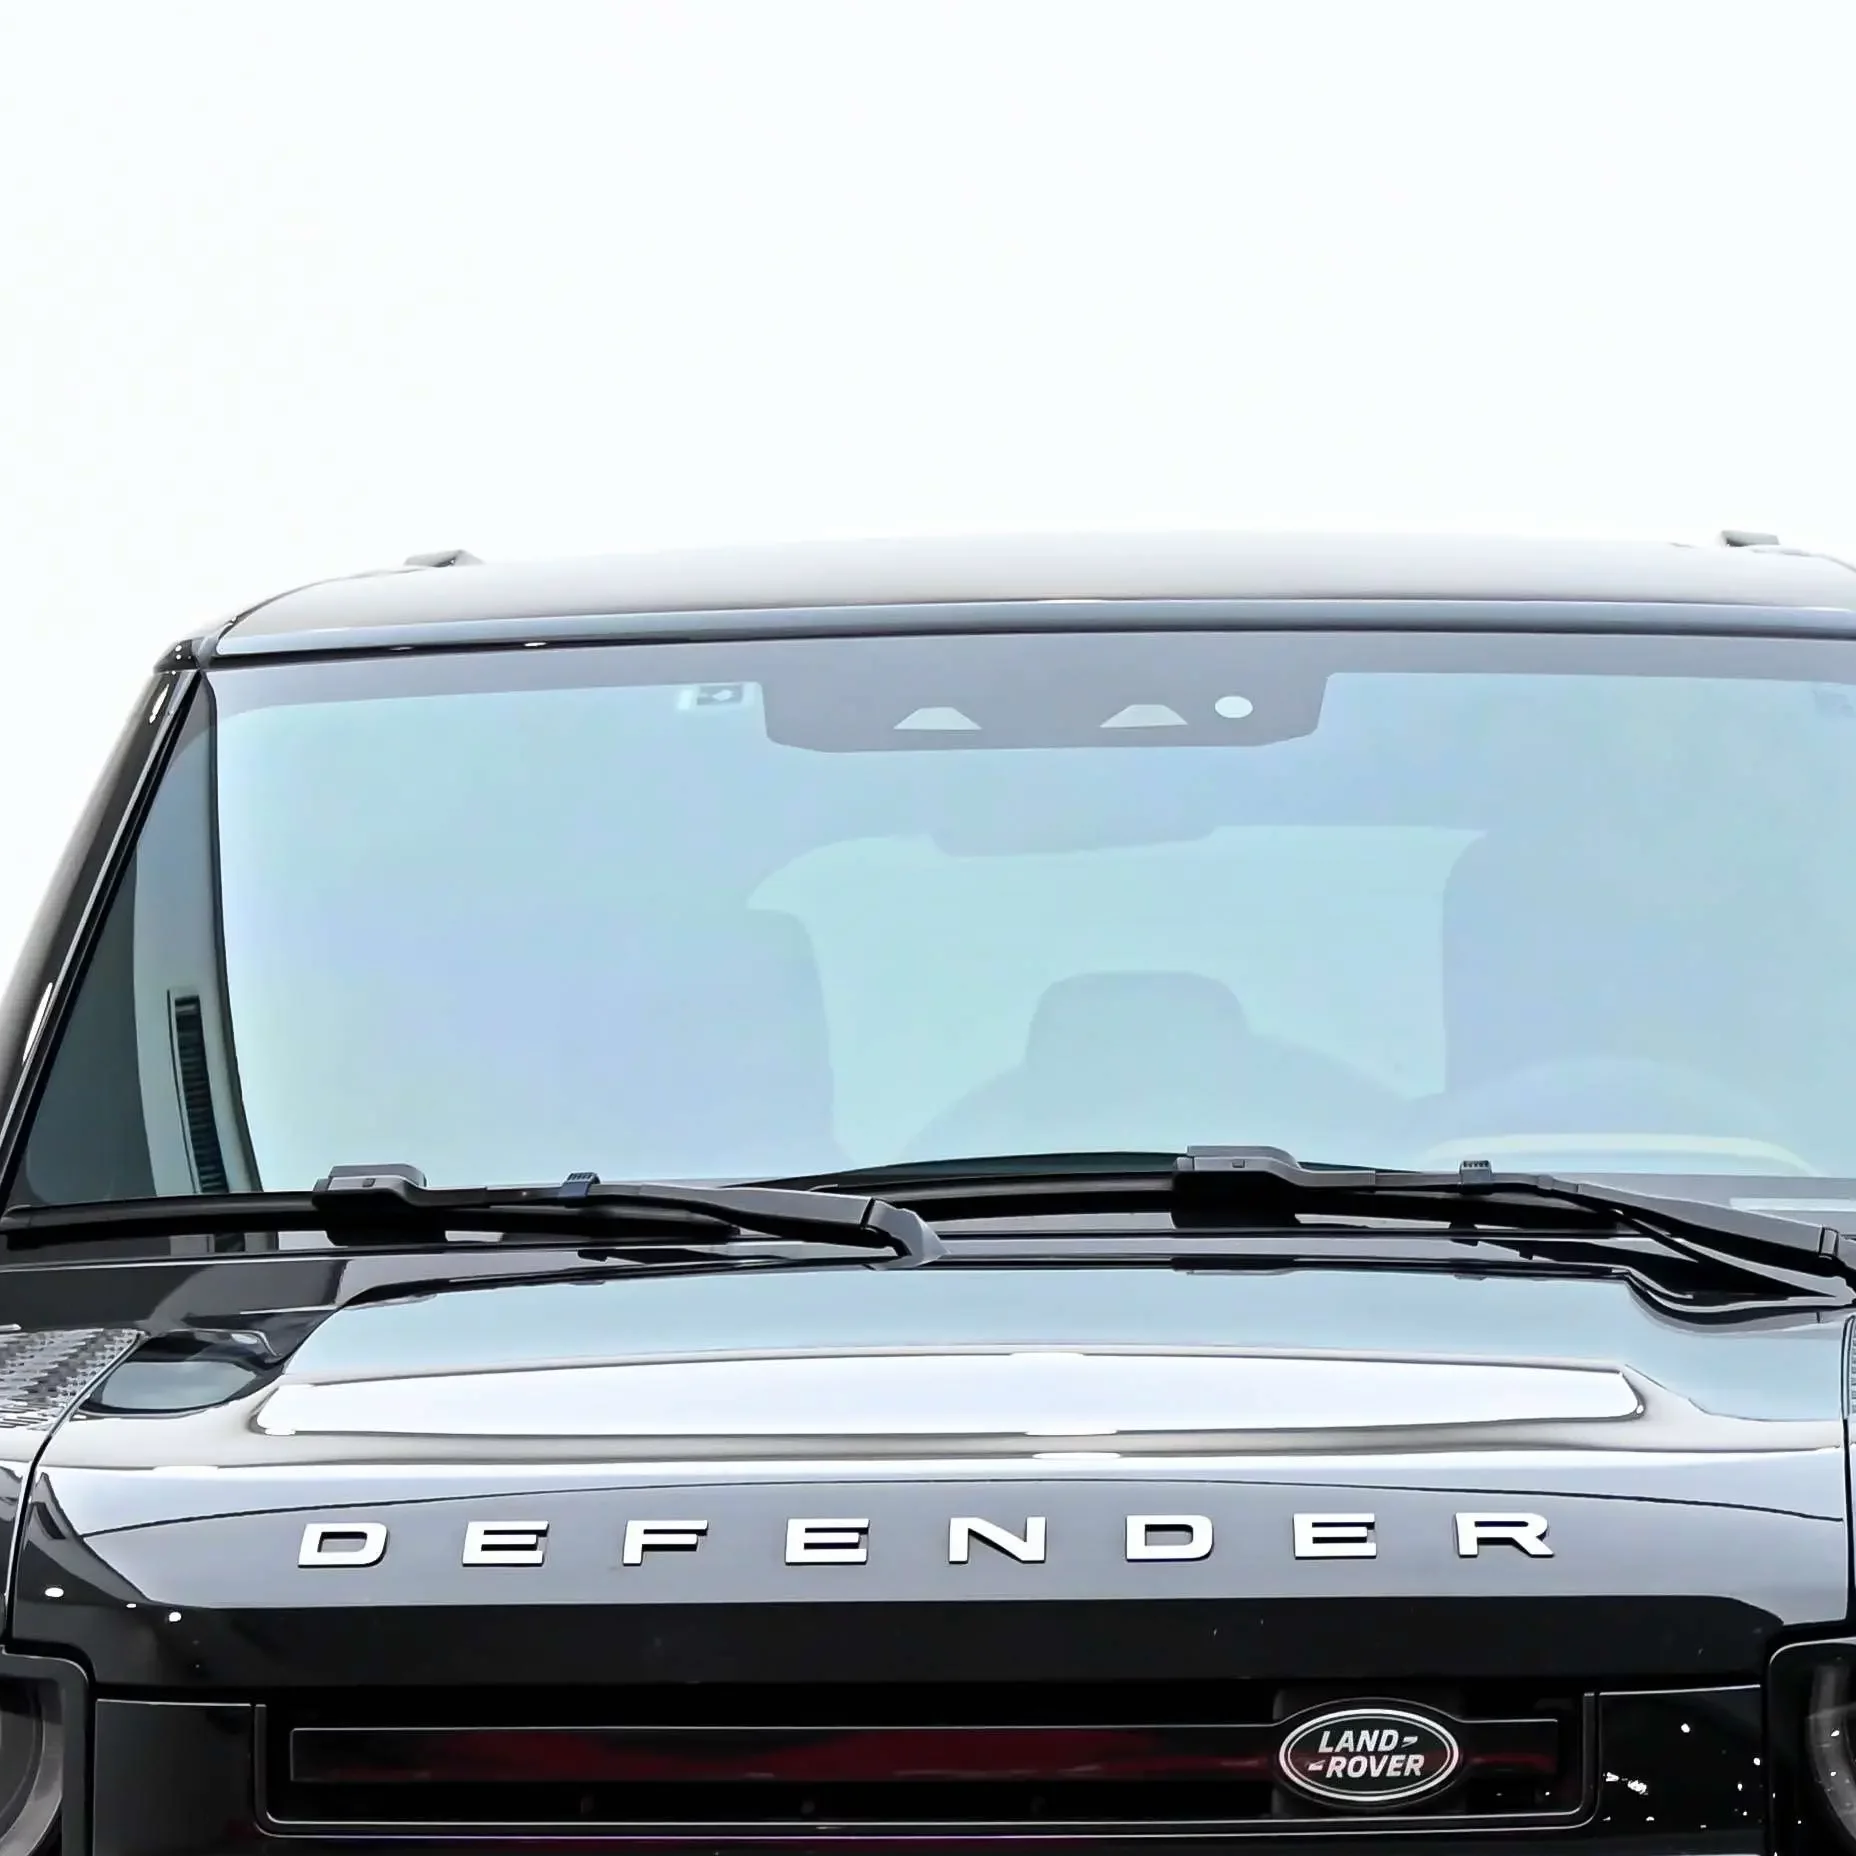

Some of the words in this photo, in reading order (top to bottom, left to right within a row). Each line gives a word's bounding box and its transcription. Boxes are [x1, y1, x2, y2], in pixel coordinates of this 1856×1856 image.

[297, 1512, 1555, 1568] DEFENDER
[1318, 1729, 1399, 1753] LAND
[1325, 1754, 1425, 1778] ROVER
